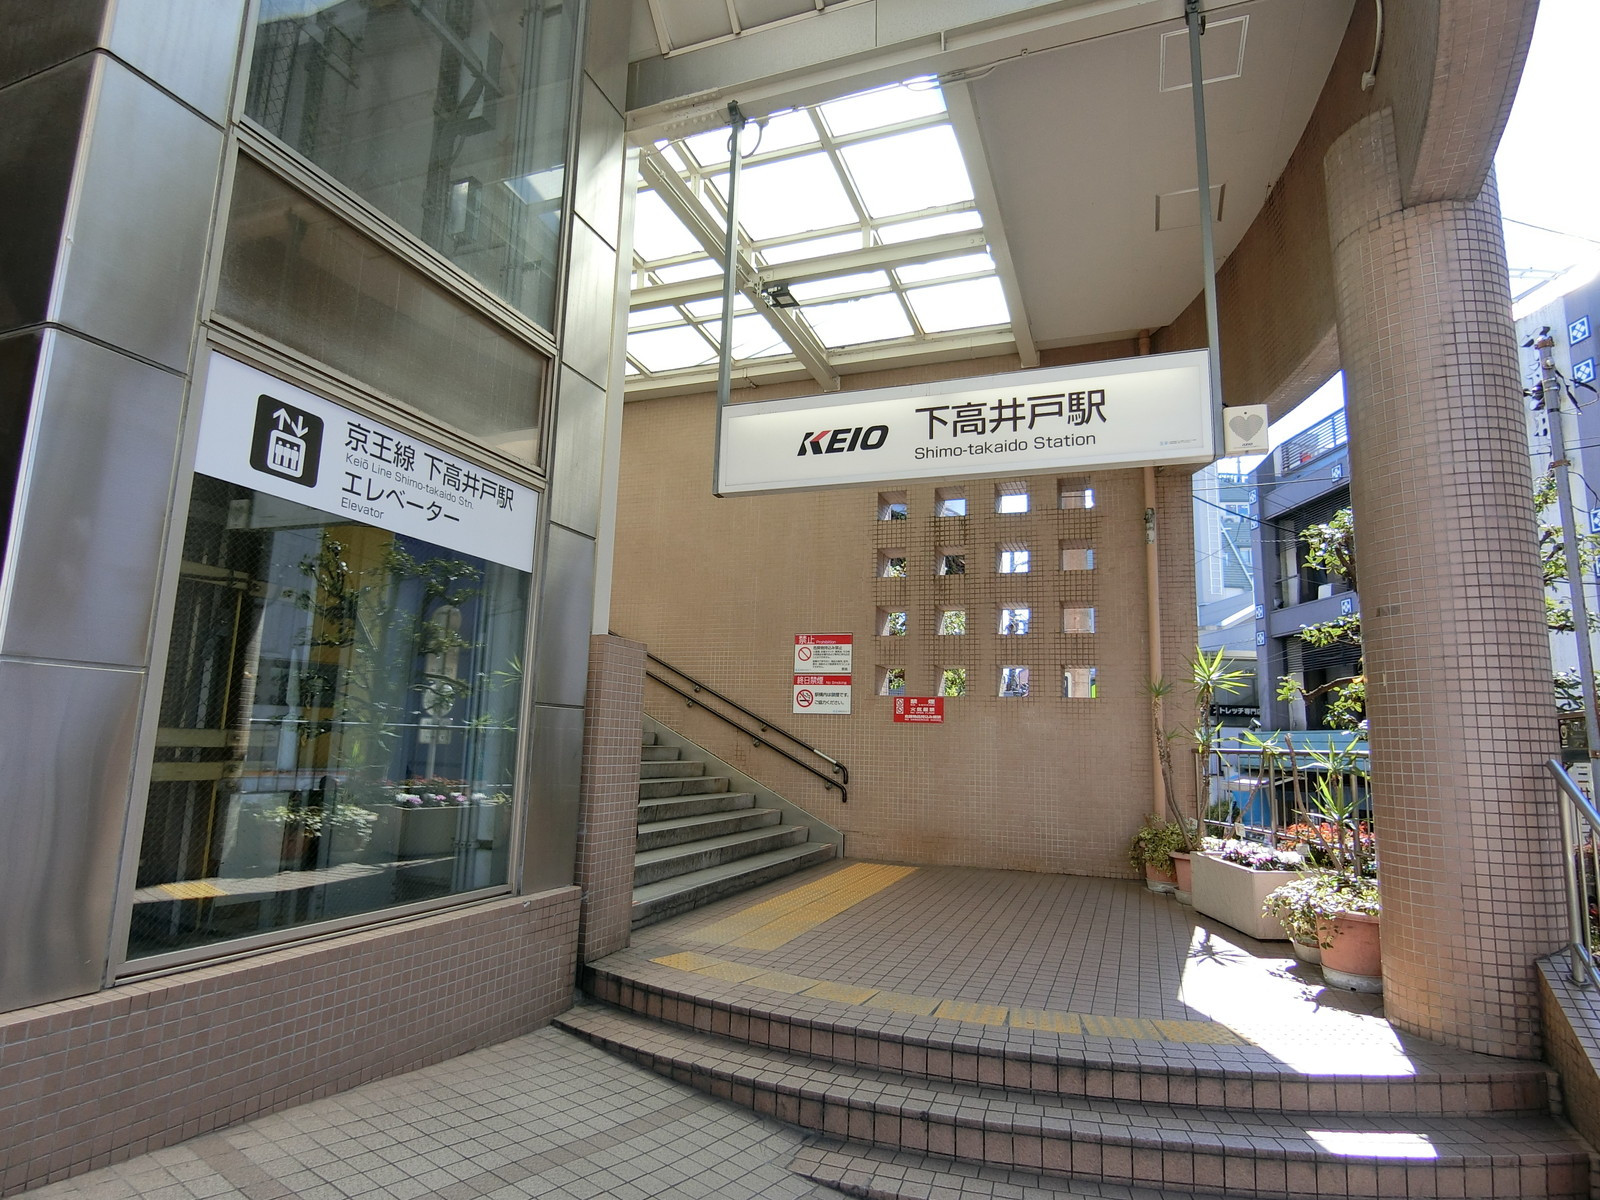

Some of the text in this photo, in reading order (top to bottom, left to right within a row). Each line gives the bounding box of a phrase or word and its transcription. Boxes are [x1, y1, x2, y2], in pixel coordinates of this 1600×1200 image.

[915, 388, 1107, 440] 下高井戸駅
[797, 425, 889, 457] KEIO
[914, 433, 1097, 460] Shimo-takaido Station
[345, 421, 514, 511] 京王線 下高井戸駅
[342, 471, 460, 522] エレベーター
[372, 462, 392, 479] Line
[395, 472, 456, 503] Shimo-takaido
[458, 496, 474, 510] Stn.
[341, 497, 384, 520] Elevator
[799, 636, 815, 644] 禁止
[797, 677, 824, 685] 終日禁煙
